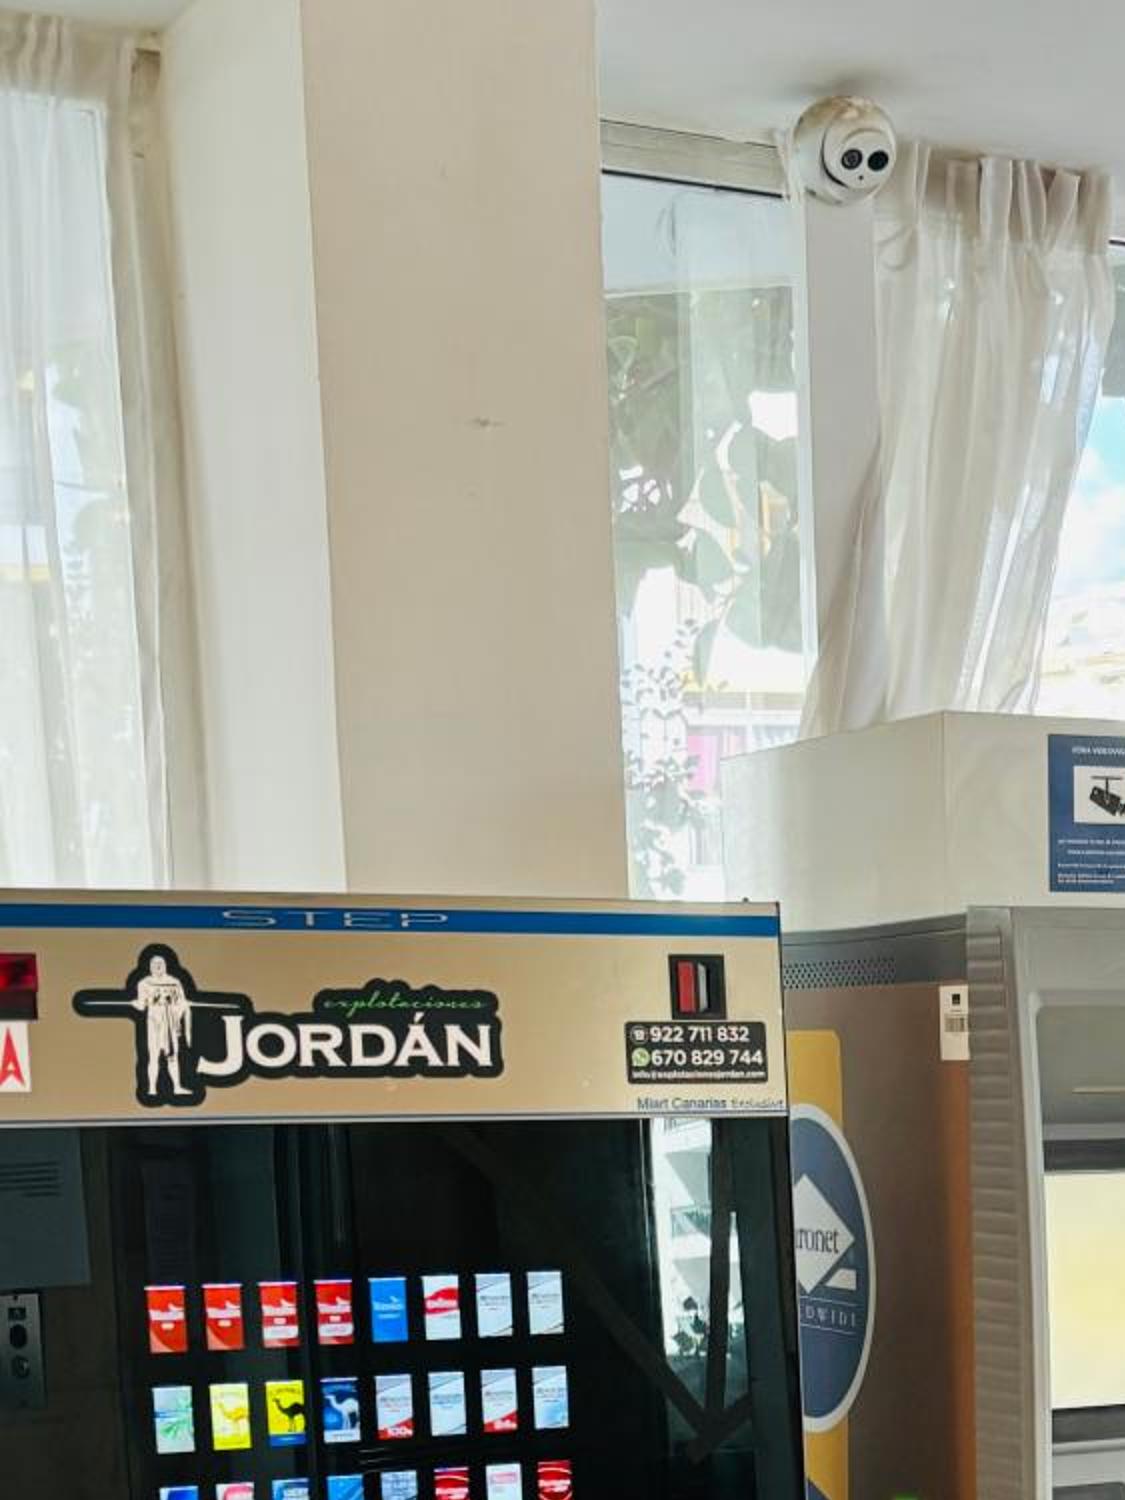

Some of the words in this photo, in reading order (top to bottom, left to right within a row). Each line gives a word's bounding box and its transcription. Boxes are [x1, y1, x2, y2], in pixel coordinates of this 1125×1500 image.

[221, 909, 449, 928] STEP
[650, 1026, 684, 1043] 922
[688, 1026, 712, 1042] 711
[717, 1026, 750, 1042] 832
[196, 1011, 494, 1077] JORDÁN
[651, 1050, 687, 1066] 670
[691, 1050, 725, 1066] 829
[730, 1050, 764, 1066] 744
